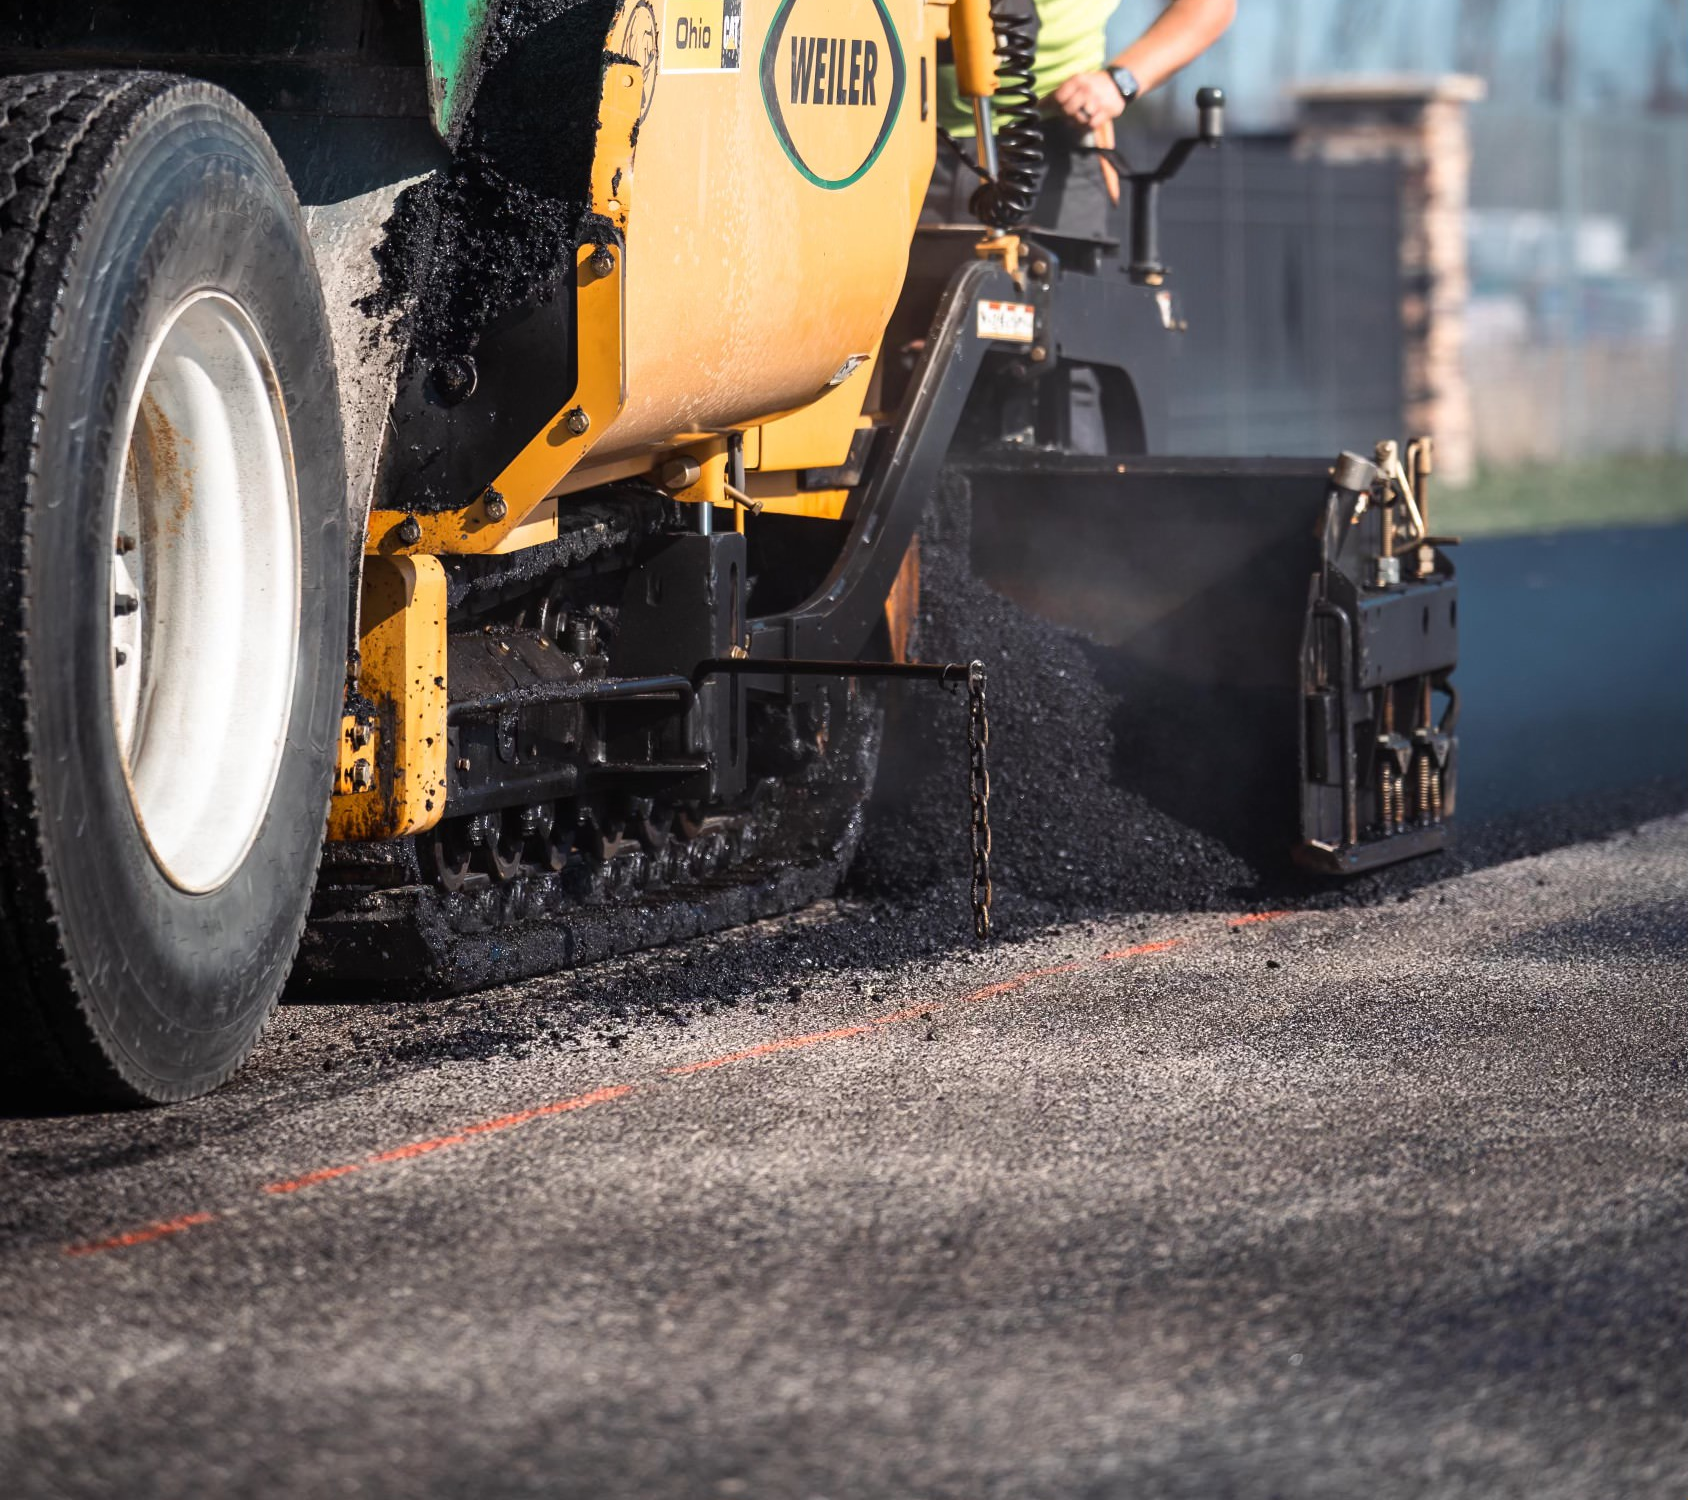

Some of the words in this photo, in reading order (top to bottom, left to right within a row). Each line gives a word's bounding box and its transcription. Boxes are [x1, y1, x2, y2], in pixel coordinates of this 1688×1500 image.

[675, 17, 711, 50] Ohio
[723, 15, 740, 50] CAT
[791, 36, 878, 106] WEILER
